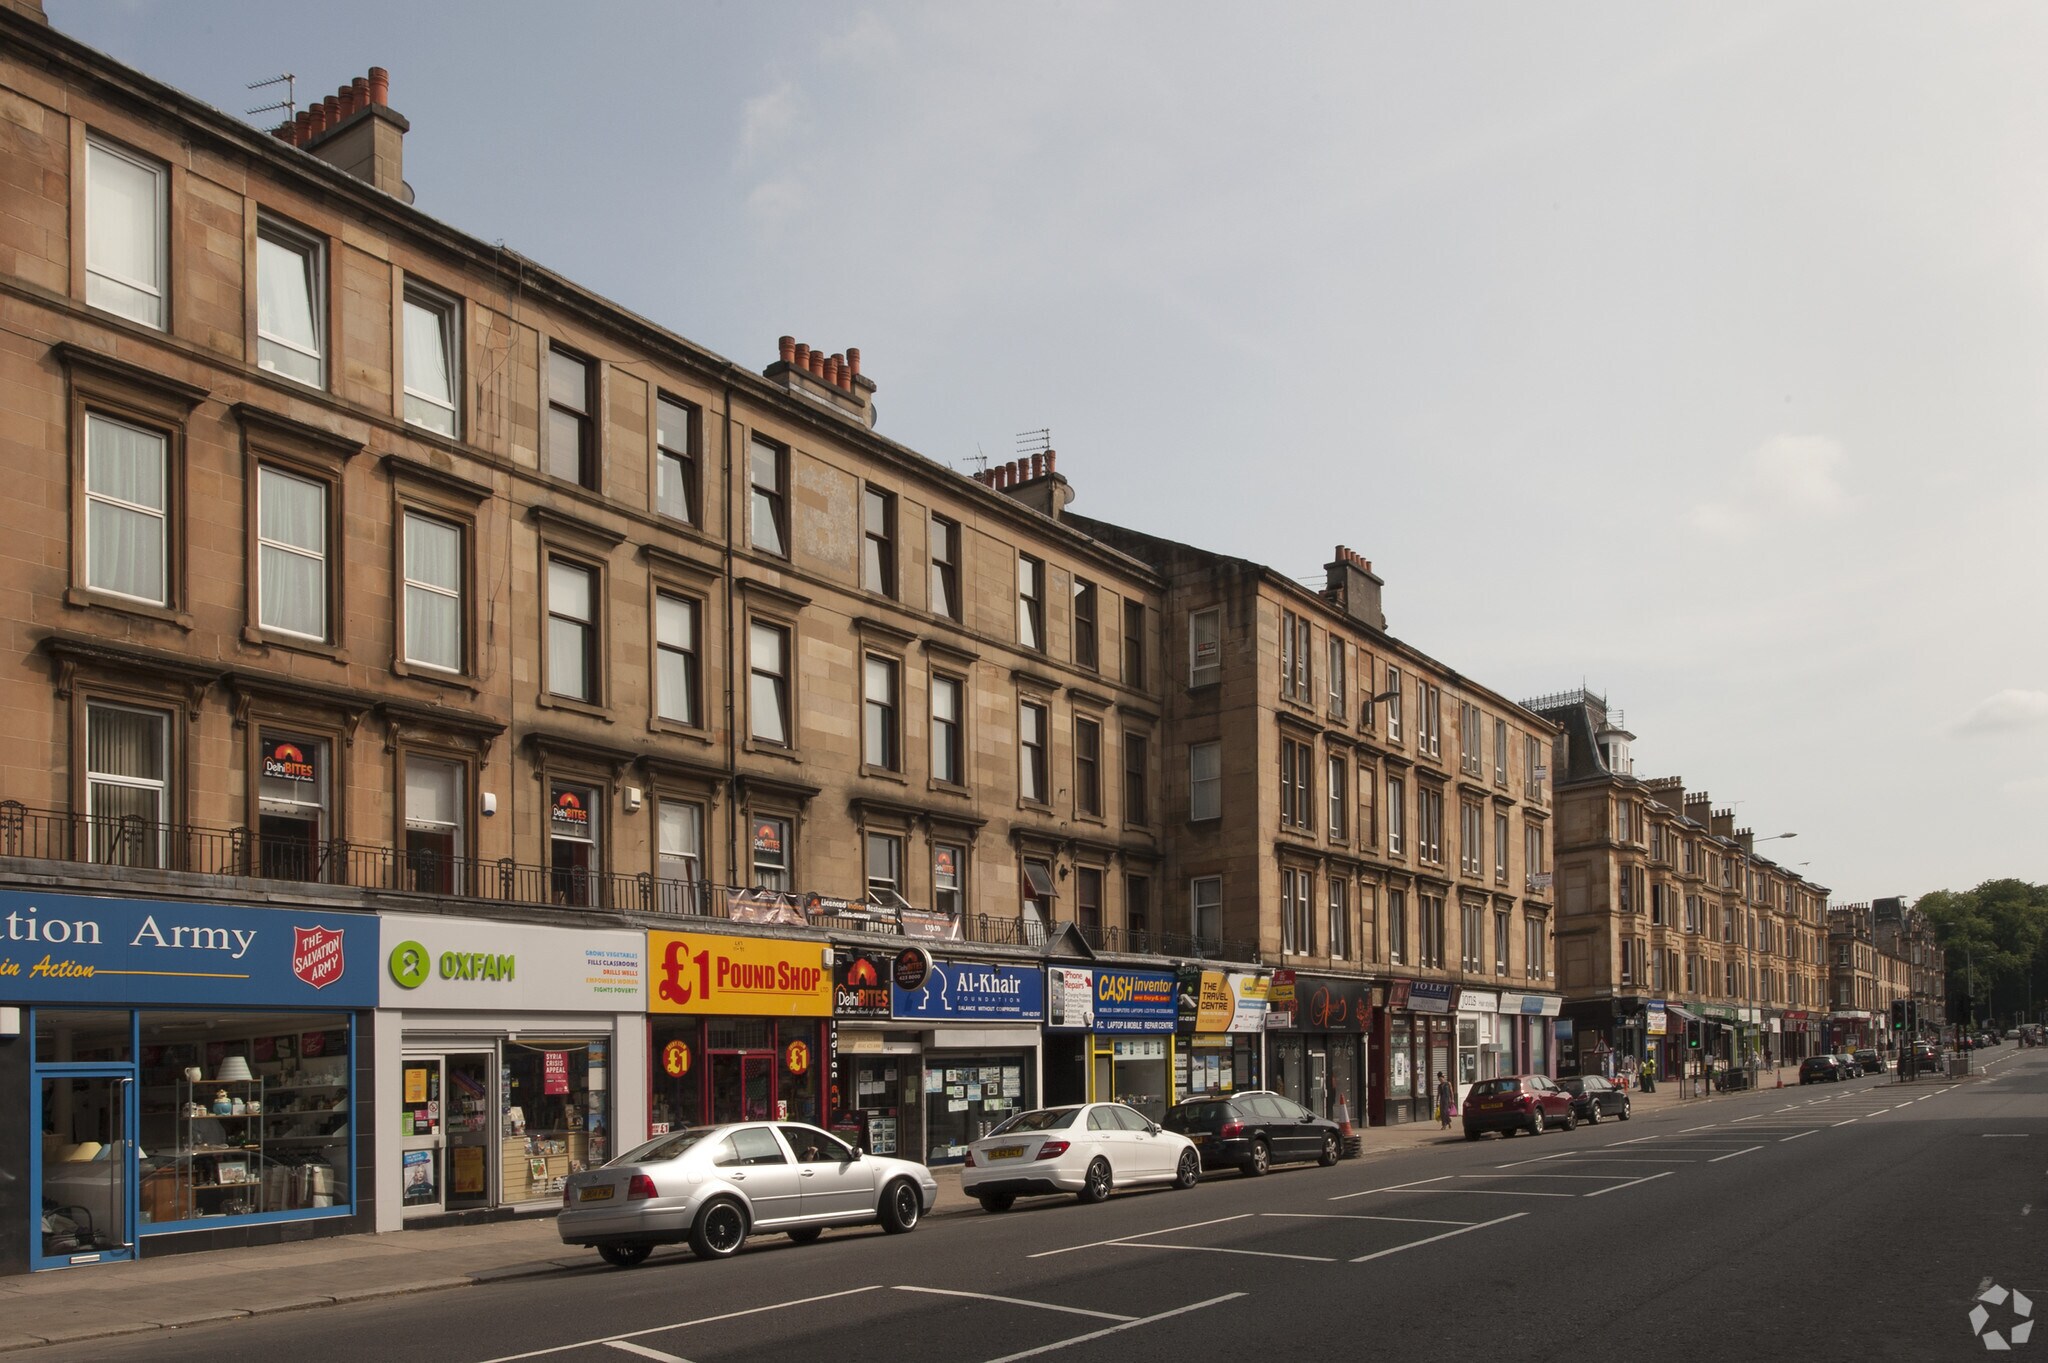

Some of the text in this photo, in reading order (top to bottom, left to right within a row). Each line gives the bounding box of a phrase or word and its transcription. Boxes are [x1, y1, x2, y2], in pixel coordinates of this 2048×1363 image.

[128, 914, 258, 959] Army
[302, 931, 323, 952] THE
[295, 935, 340, 973] SALVATION
[29, 954, 95, 978] Action
[311, 953, 338, 981] ARMY
[440, 950, 516, 981] OXFAM
[603, 960, 638, 968] CLASSROOMS
[1185, 966, 1199, 974] PIA
[659, 941, 709, 1006] £1
[1064, 970, 1083, 980] iPhone
[956, 972, 1021, 994] Al-Khair
[1064, 980, 1084, 991] Repairs
[1134, 977, 1173, 993] inventor
[1204, 982, 1217, 991] THE
[1414, 982, 1449, 993] TO LET
[838, 989, 888, 1007] DelhiBITES
[957, 995, 1020, 1003] FOUNDATION
[1202, 992, 1229, 1001] TRAVEL
[1201, 1002, 1228, 1011] CENTRE
[1107, 1021, 1124, 1029] LAPTOP
[667, 1048, 688, 1074] £1
[789, 1048, 807, 1072] £1
[545, 1066, 566, 1074] APPEAL
